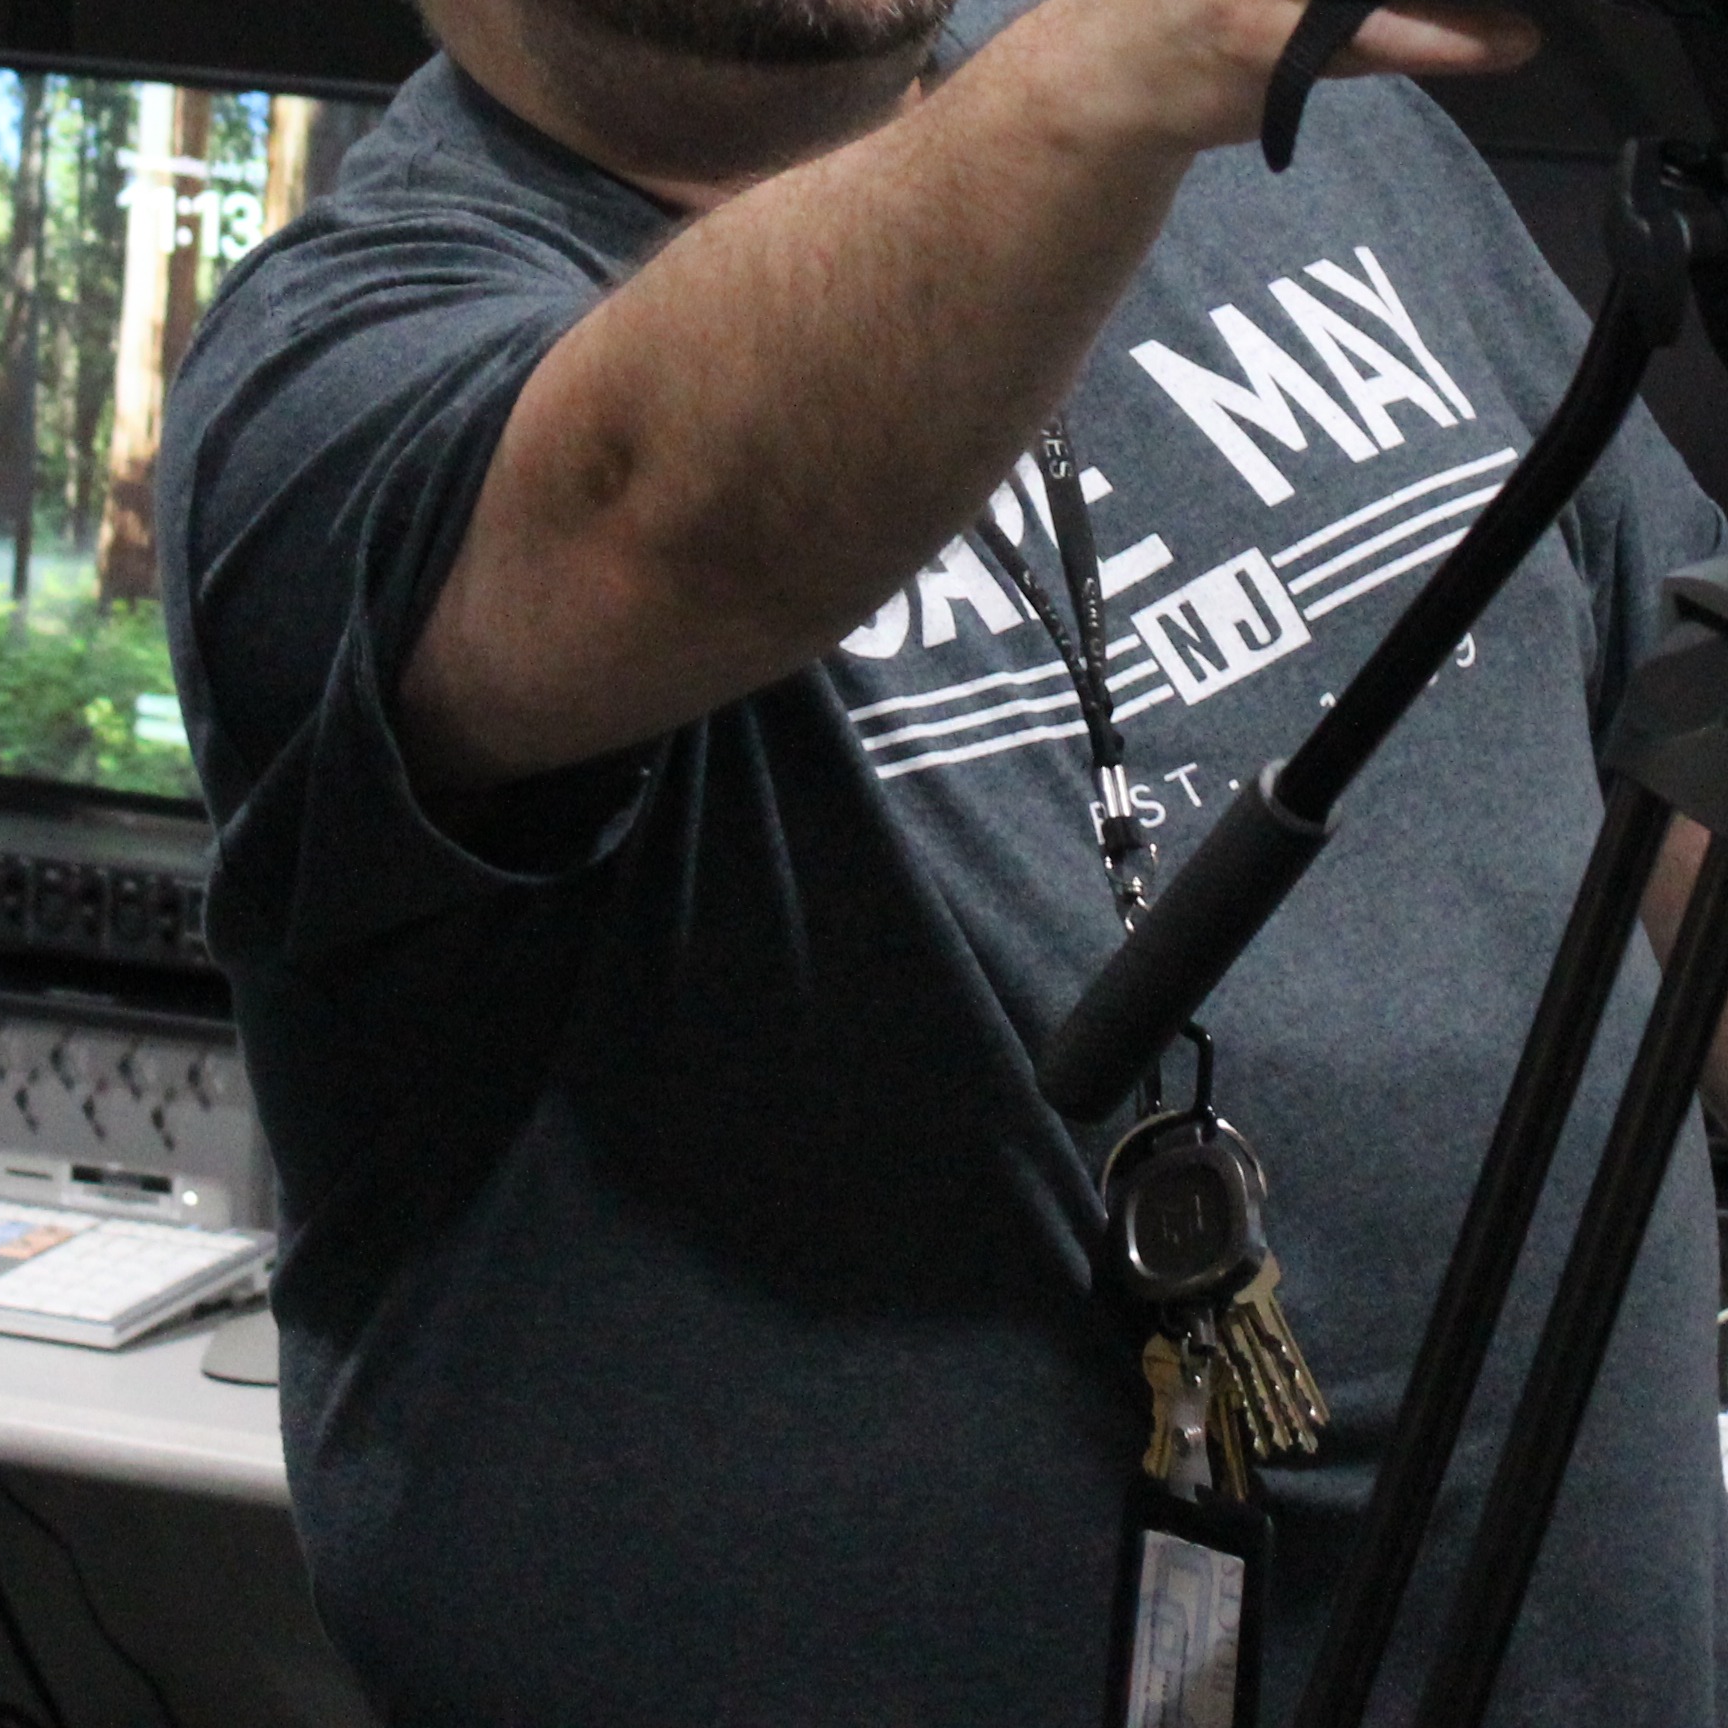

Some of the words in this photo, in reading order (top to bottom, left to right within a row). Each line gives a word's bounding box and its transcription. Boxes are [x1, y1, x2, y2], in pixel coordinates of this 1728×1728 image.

[116, 179, 264, 262] 11:13
[1129, 245, 1477, 508] MAY
[1155, 568, 1284, 685] NJ
